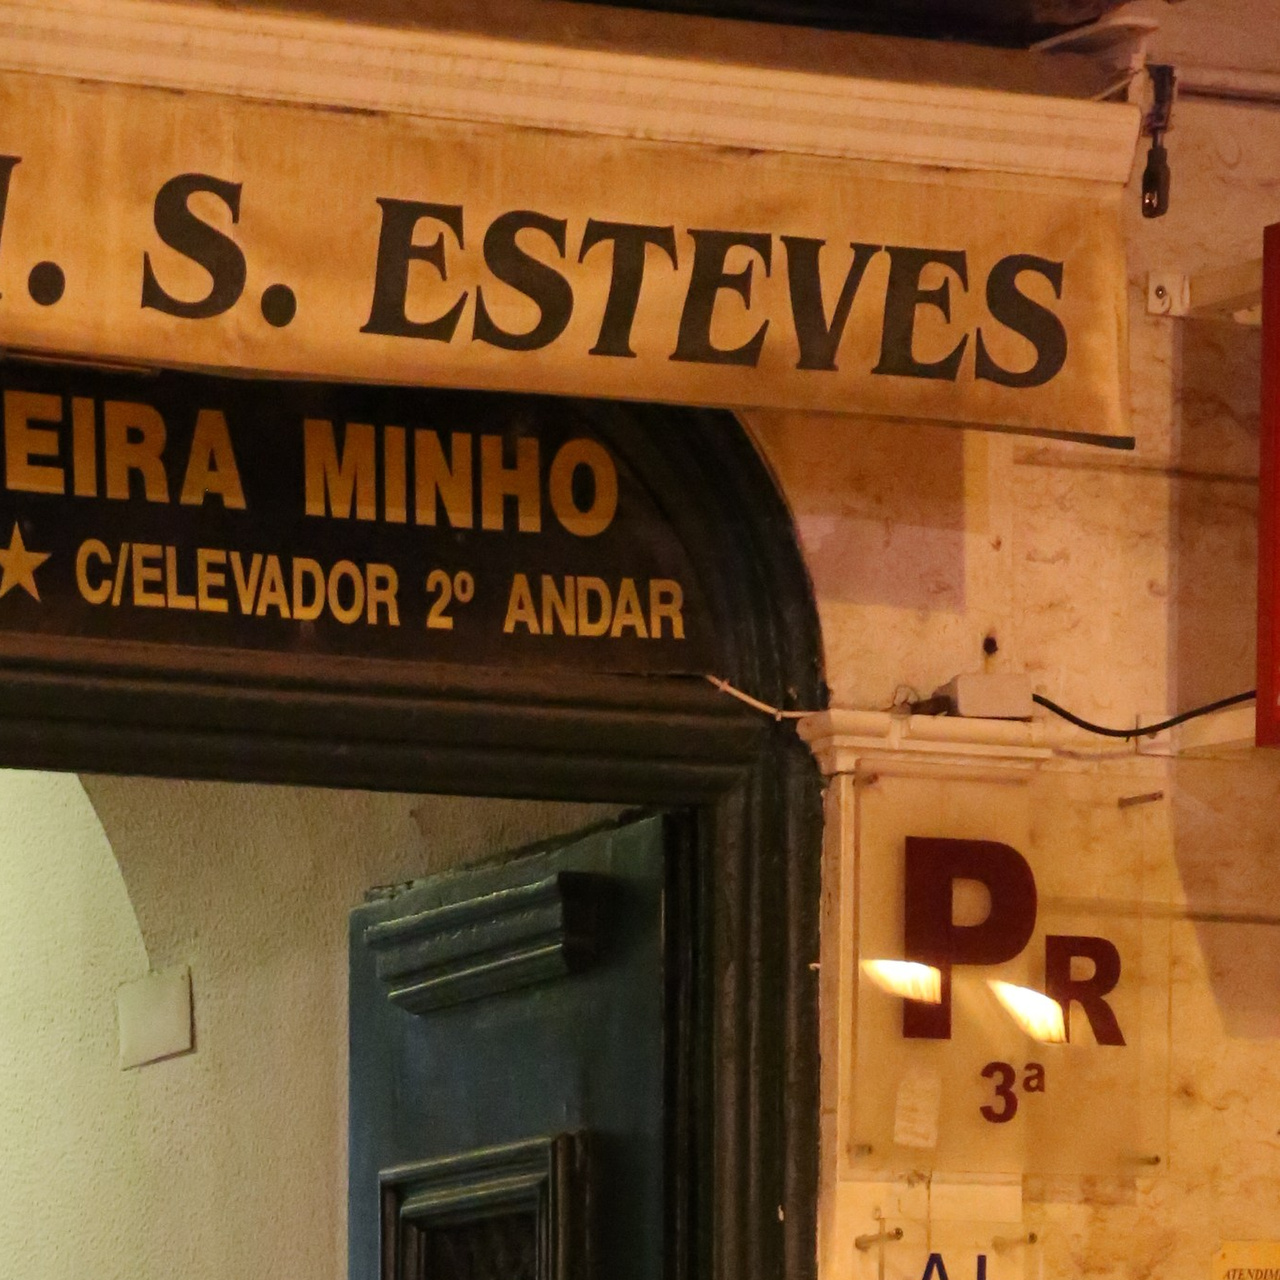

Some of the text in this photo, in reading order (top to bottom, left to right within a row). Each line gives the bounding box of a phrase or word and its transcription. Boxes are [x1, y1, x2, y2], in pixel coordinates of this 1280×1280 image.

[140, 173, 297, 328] S.
[359, 198, 1069, 388] ESTEVES
[303, 418, 619, 537] MINHO
[75, 537, 400, 627] C/ELEVADOR
[426, 569, 475, 629] 2º
[503, 574, 685, 640] ANDAR
[1224, 1268, 1280, 1280] ATENDIM
